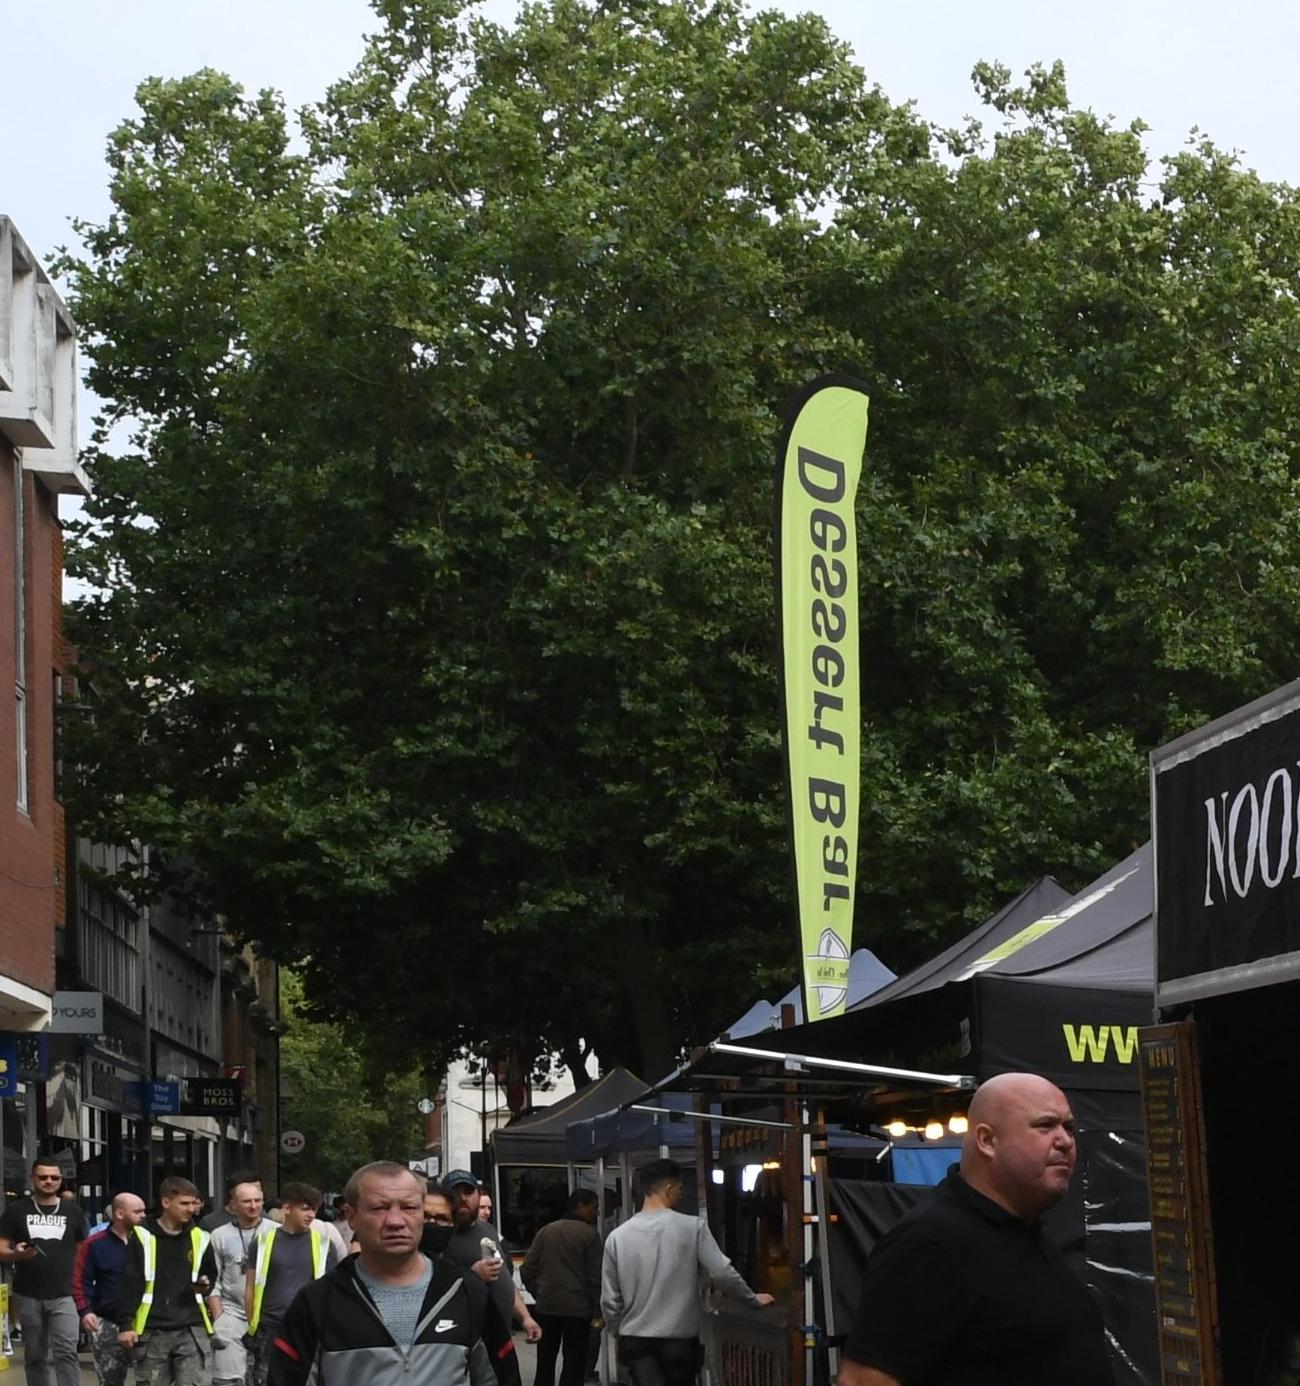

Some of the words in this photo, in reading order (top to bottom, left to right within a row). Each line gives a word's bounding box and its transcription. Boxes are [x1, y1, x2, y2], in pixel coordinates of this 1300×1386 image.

[59, 1007, 96, 1018] YOURS
[1148, 1046, 1175, 1069] MENU
[153, 1084, 170, 1092] The
[203, 1088, 234, 1097] MOSS
[26, 1214, 67, 1226] PRAGUE
